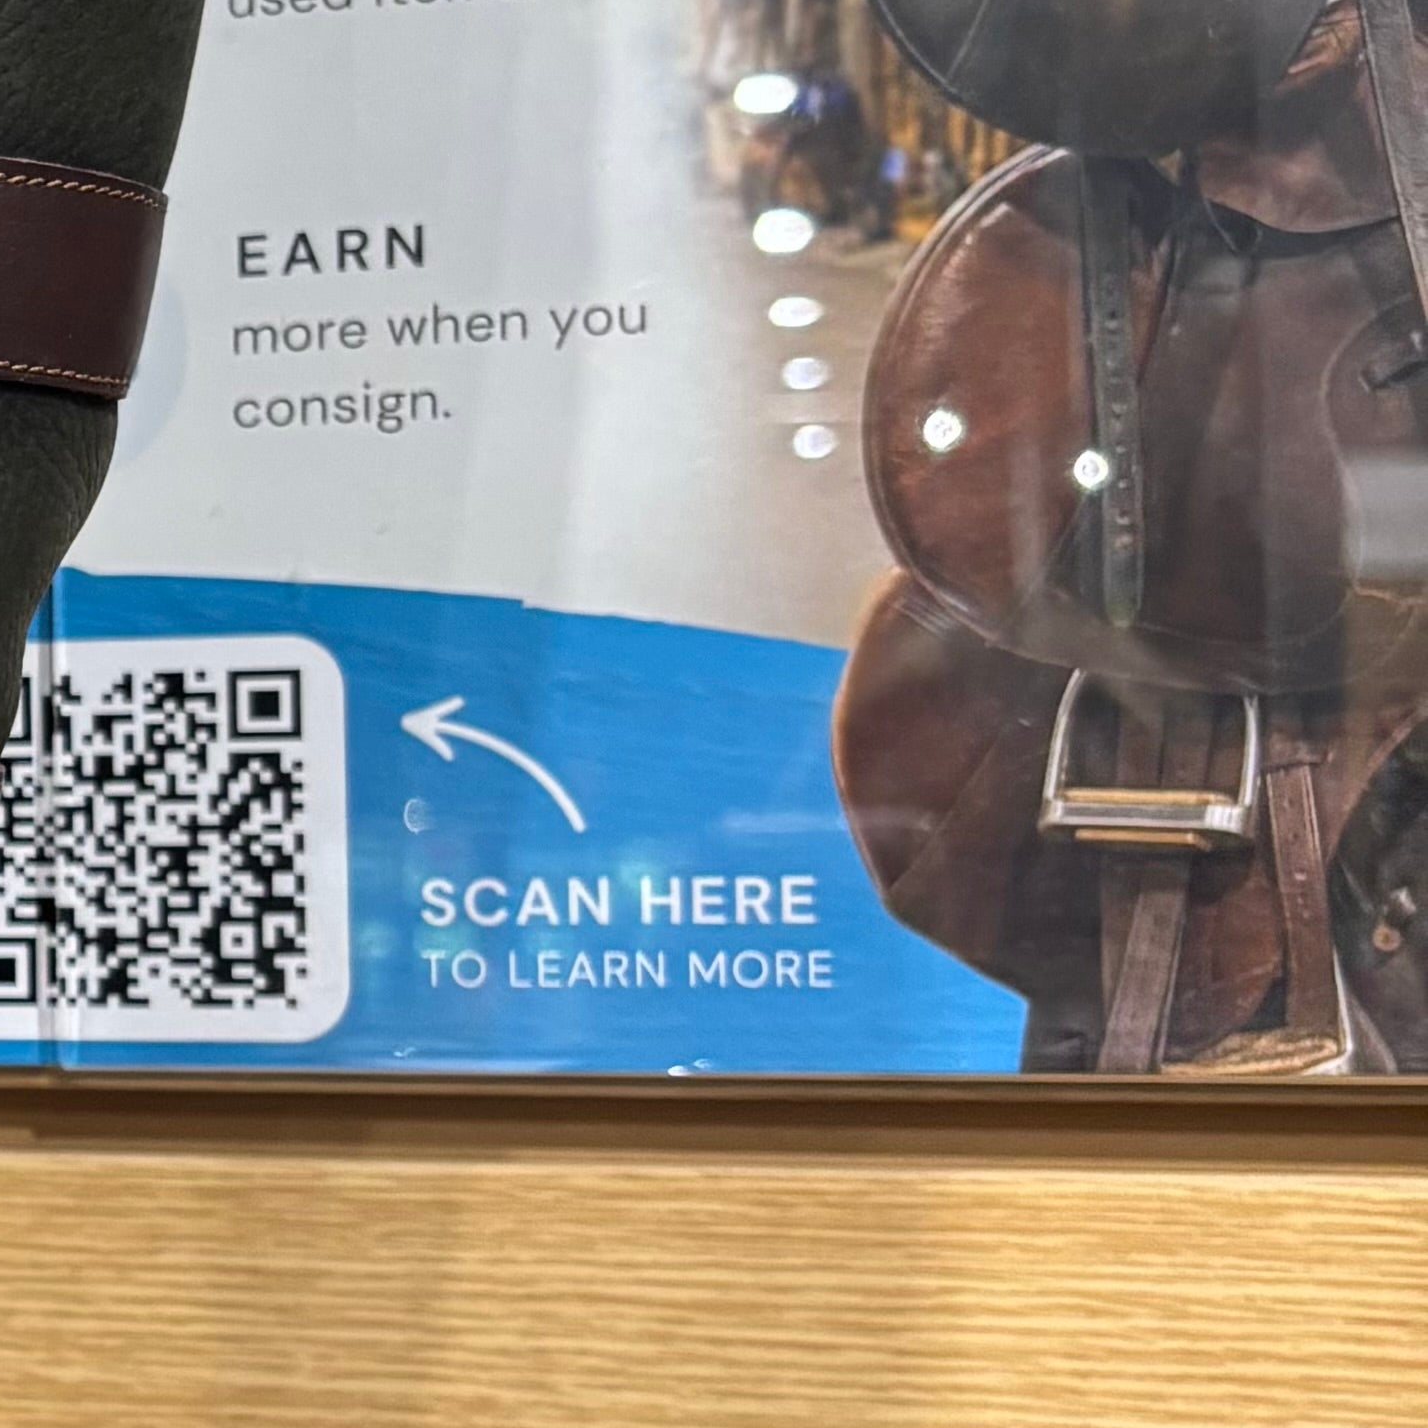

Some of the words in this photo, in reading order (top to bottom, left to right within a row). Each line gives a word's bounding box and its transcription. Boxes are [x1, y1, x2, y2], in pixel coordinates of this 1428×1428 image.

[236, 224, 426, 278] EARN
[232, 318, 368, 356] more
[386, 302, 529, 347] when
[548, 303, 649, 350] you
[232, 380, 453, 435] consign.
[419, 875, 613, 928] SCAN
[637, 874, 819, 926] HERE
[420, 949, 488, 989] TO
[507, 949, 667, 989] LEARN
[687, 949, 834, 989] MORE
